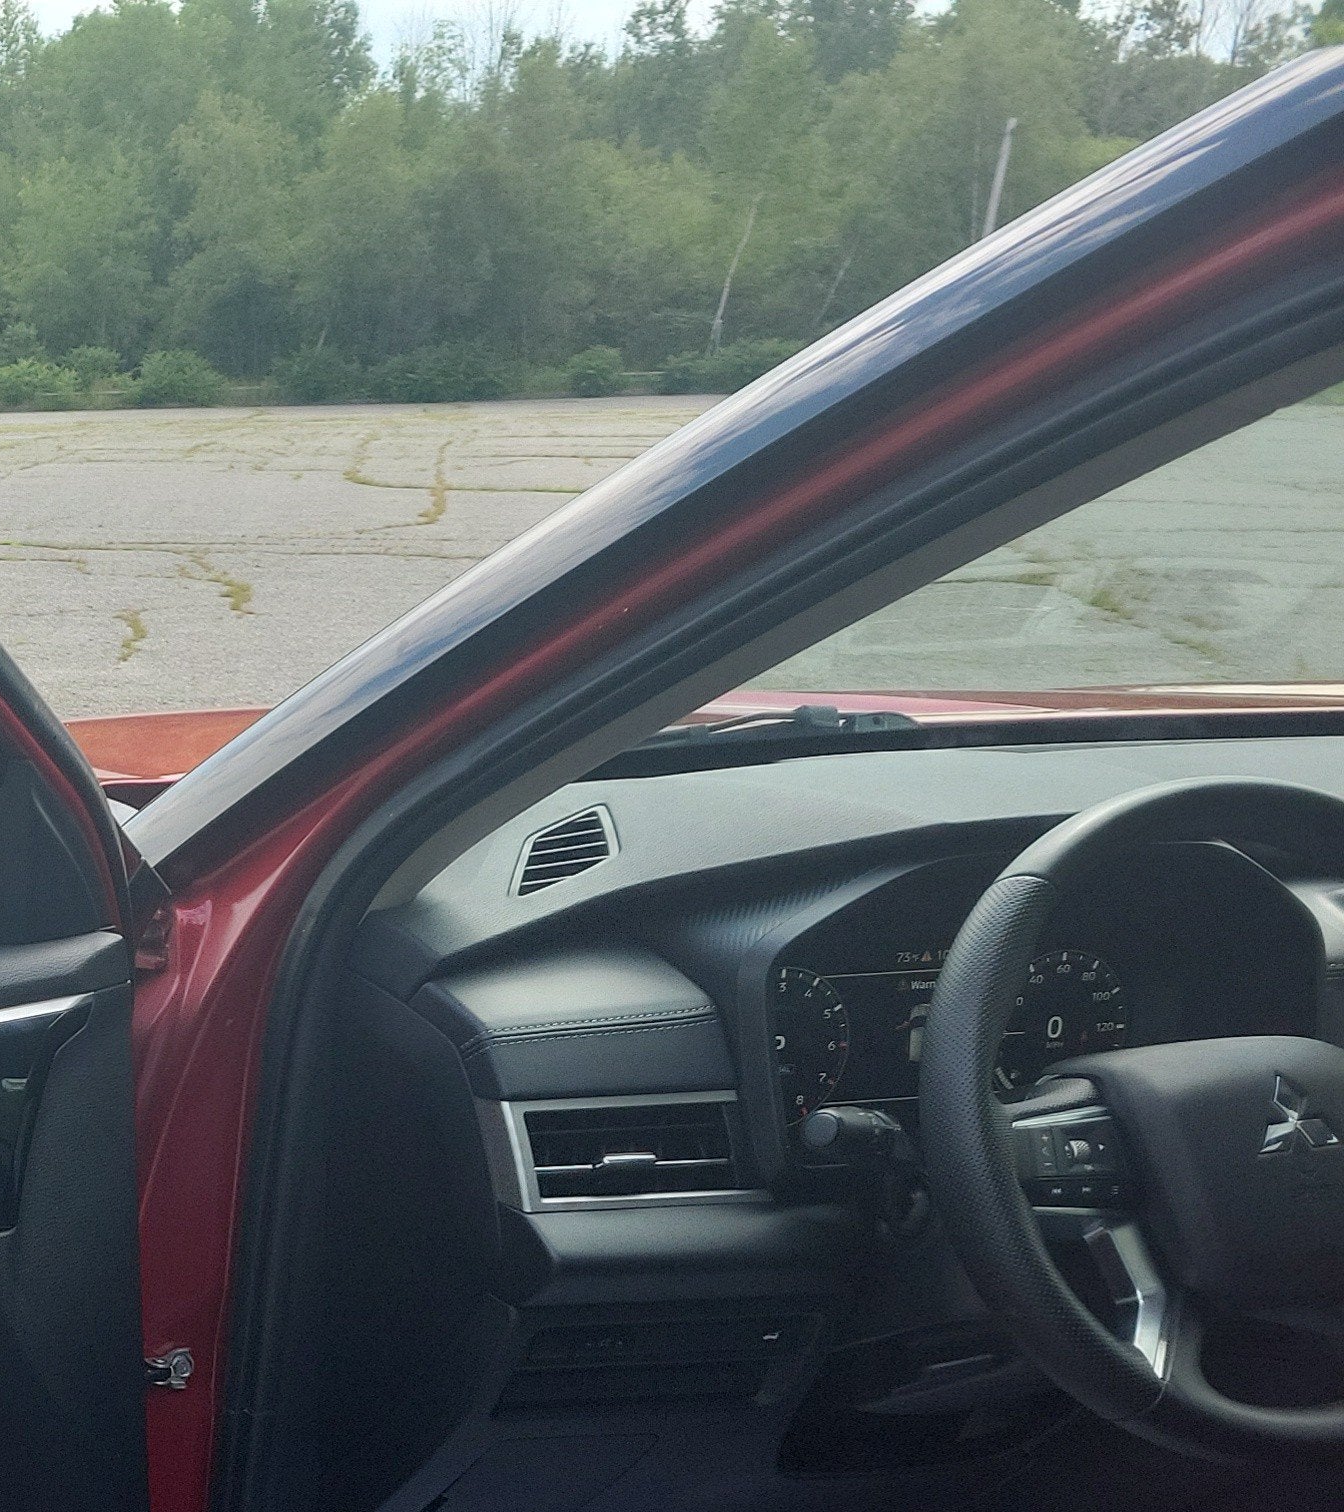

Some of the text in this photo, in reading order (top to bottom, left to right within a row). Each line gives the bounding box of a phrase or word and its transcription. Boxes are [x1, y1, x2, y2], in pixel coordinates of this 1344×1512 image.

[1056, 964, 1071, 974] 60
[1029, 974, 1044, 984] 40
[1081, 972, 1096, 981] 80
[779, 982, 787, 993] 3
[804, 989, 812, 998] 4
[1092, 991, 1111, 1001] 100
[823, 1008, 831, 1019] 5
[1047, 1015, 1063, 1038] 0
[1096, 1022, 1114, 1032] 120
[827, 1040, 836, 1051] 6
[818, 1072, 827, 1083] 7
[796, 1095, 804, 1105] 8
